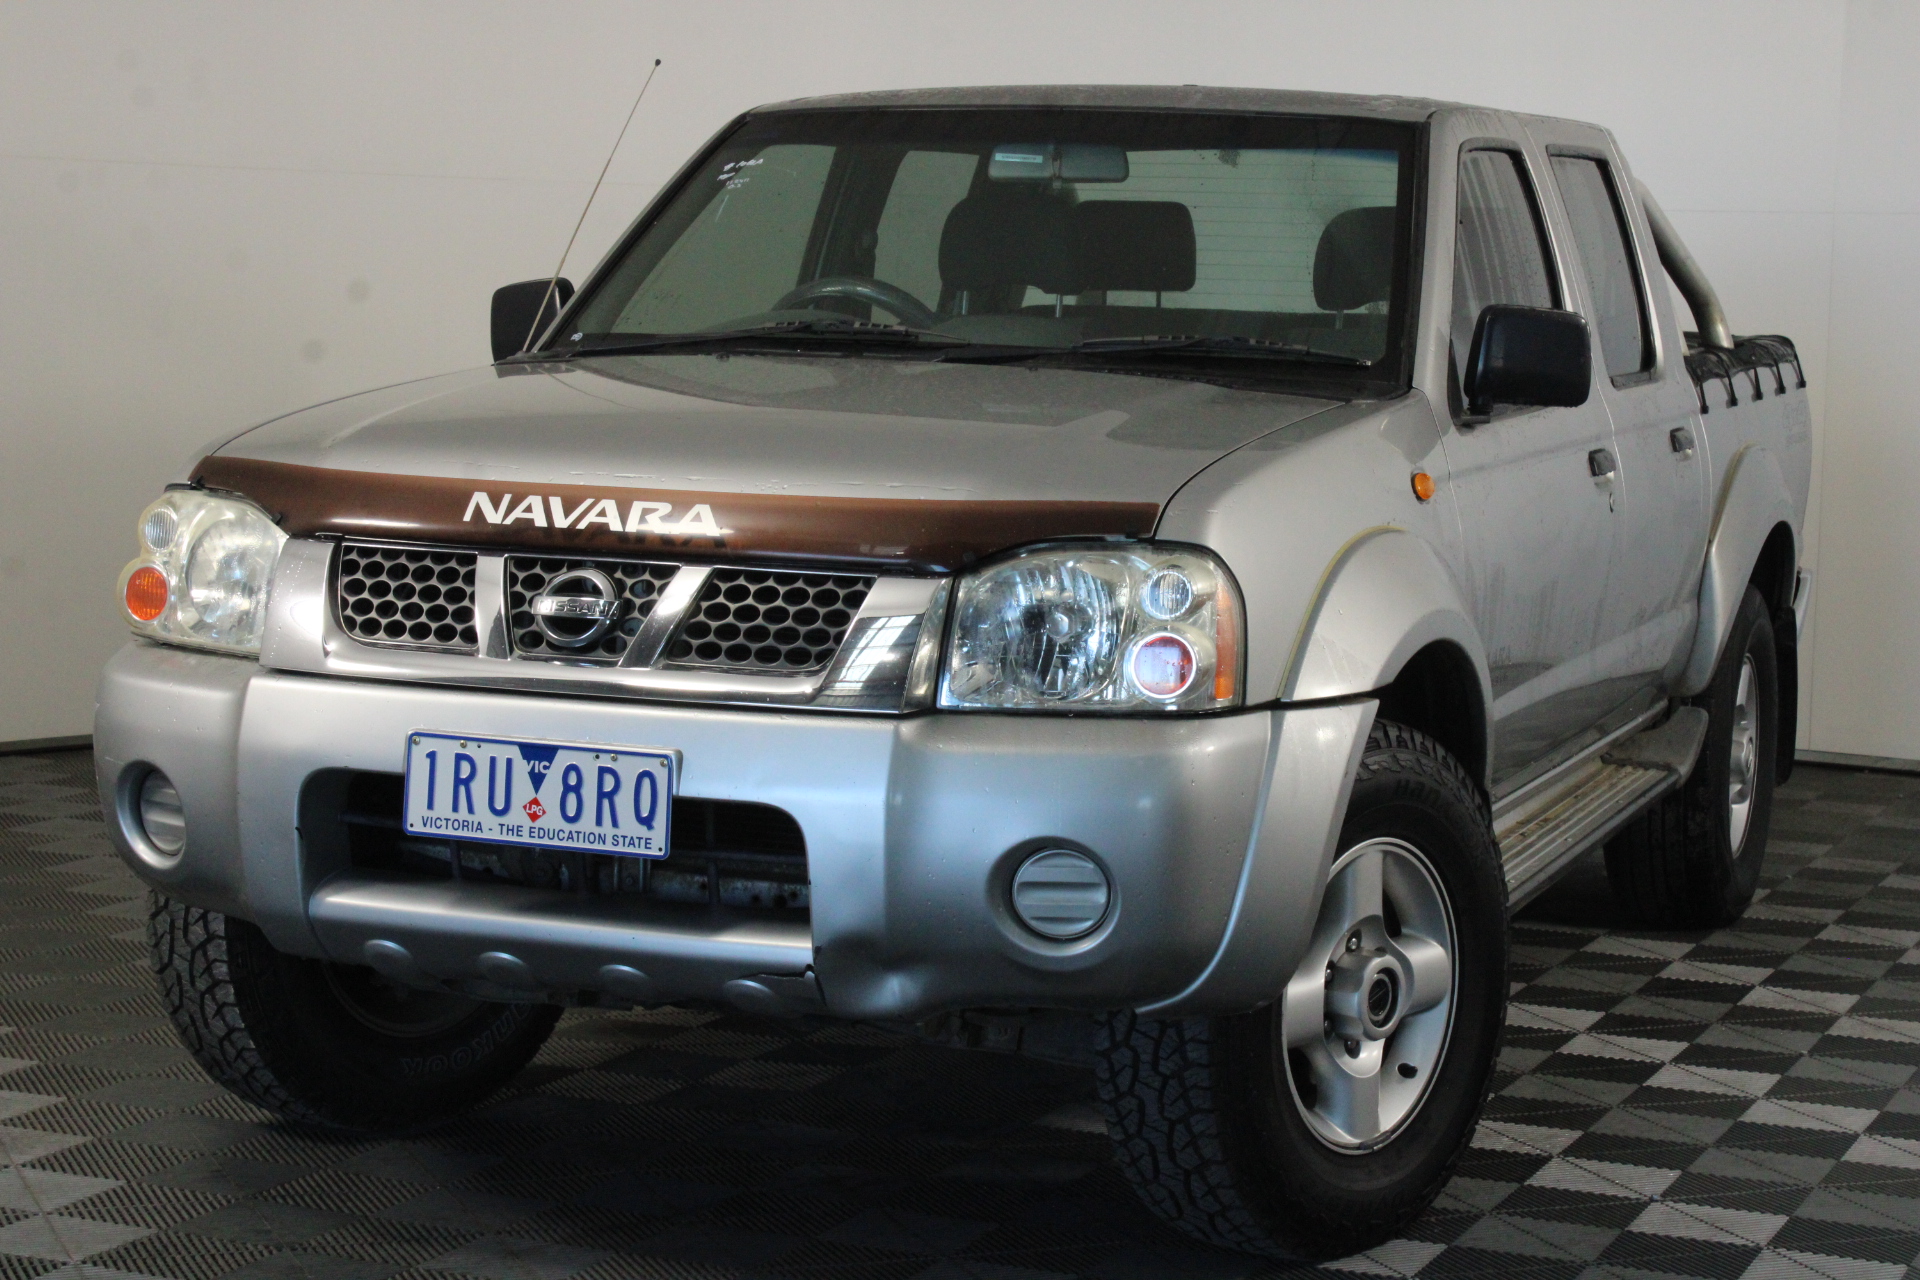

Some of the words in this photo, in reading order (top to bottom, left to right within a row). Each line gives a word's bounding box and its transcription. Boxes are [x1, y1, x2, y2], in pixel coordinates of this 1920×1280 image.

[463, 491, 721, 537] NAVARA
[425, 749, 513, 817] 1RU
[524, 760, 550, 774] VIC
[526, 803, 543, 816] LPG
[559, 762, 658, 830] 8RQ
[421, 815, 484, 834] VICTORIA
[498, 823, 523, 838] THE
[528, 826, 606, 846] EDUCATION
[611, 834, 652, 850] STATE
